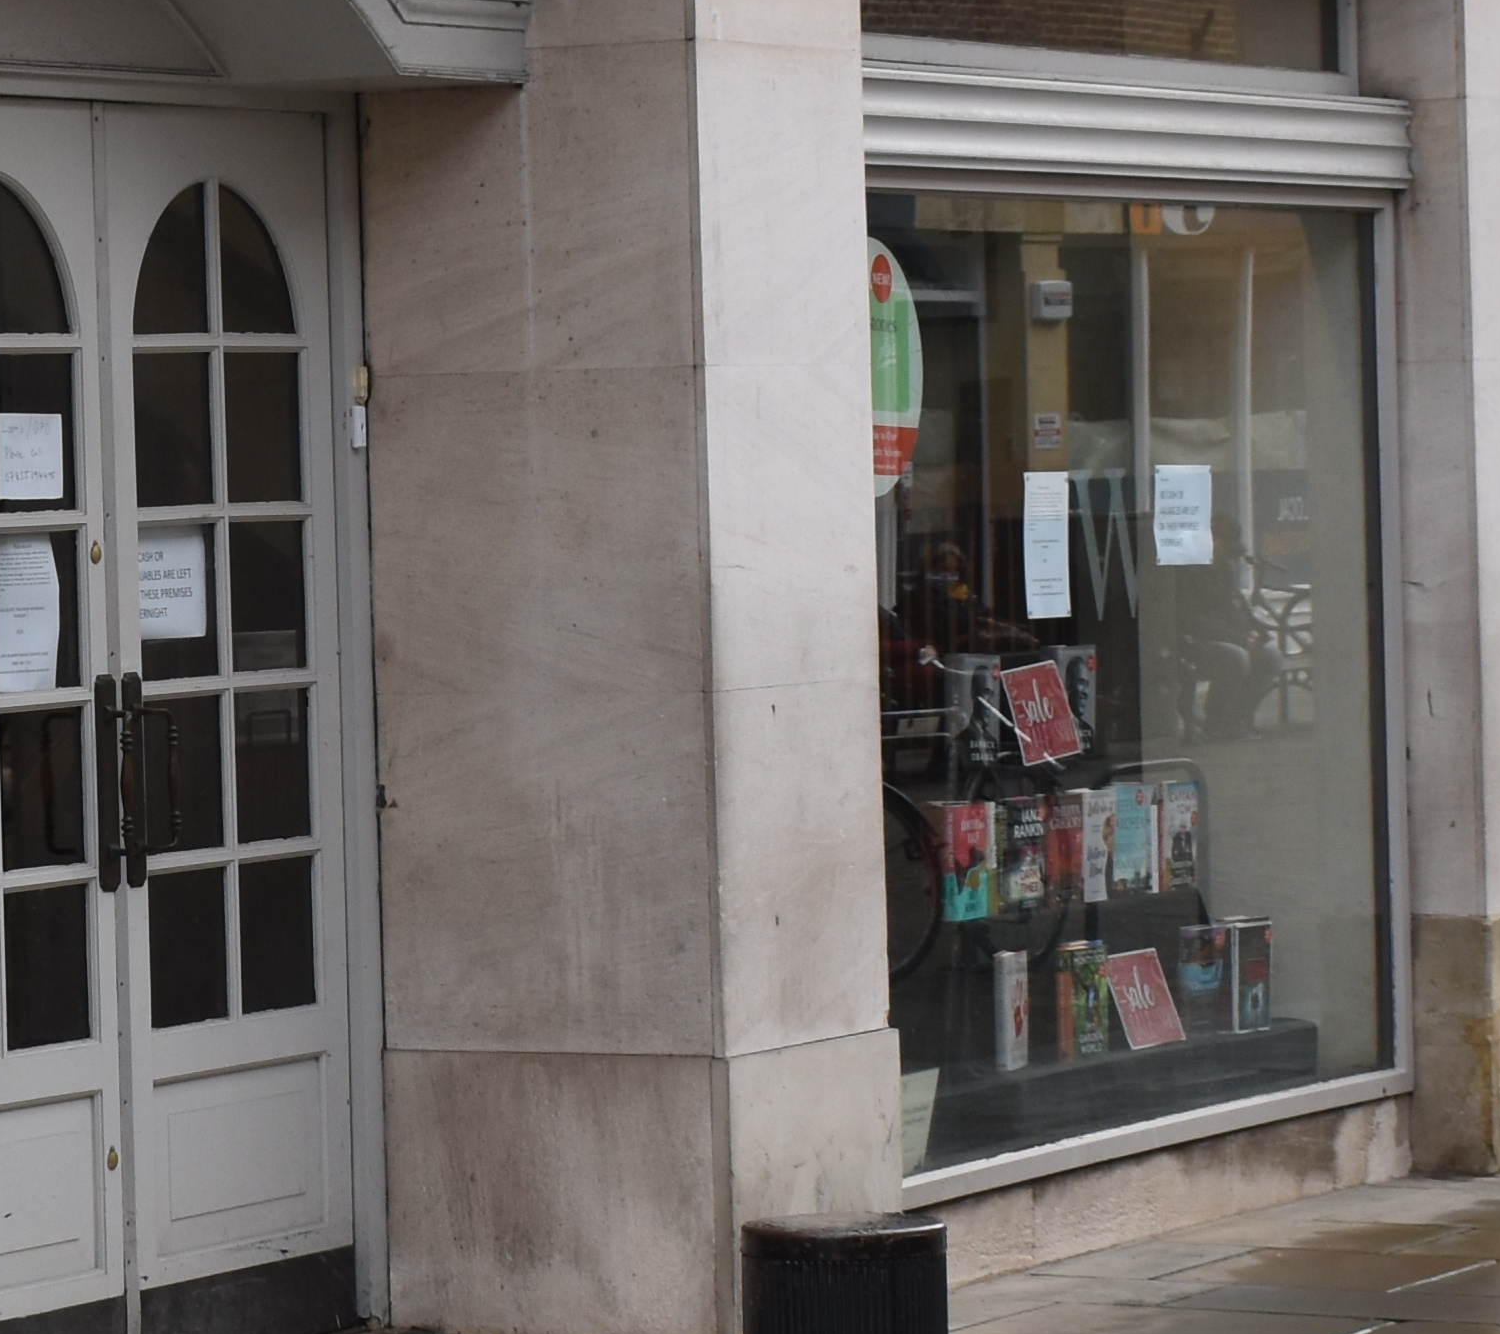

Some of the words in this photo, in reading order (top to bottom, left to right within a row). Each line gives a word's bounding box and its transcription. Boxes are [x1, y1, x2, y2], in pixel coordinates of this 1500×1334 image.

[138, 551, 154, 563] CASH
[154, 551, 165, 562] OR
[161, 568, 176, 581] ARE
[176, 567, 192, 580] LEFT
[140, 587, 159, 600] THESE
[160, 586, 193, 599] PREMISES
[1021, 678, 1055, 728] sale
[1021, 808, 1036, 821] IAN
[1013, 821, 1044, 838] RANKIN
[1123, 964, 1155, 1013] sale
